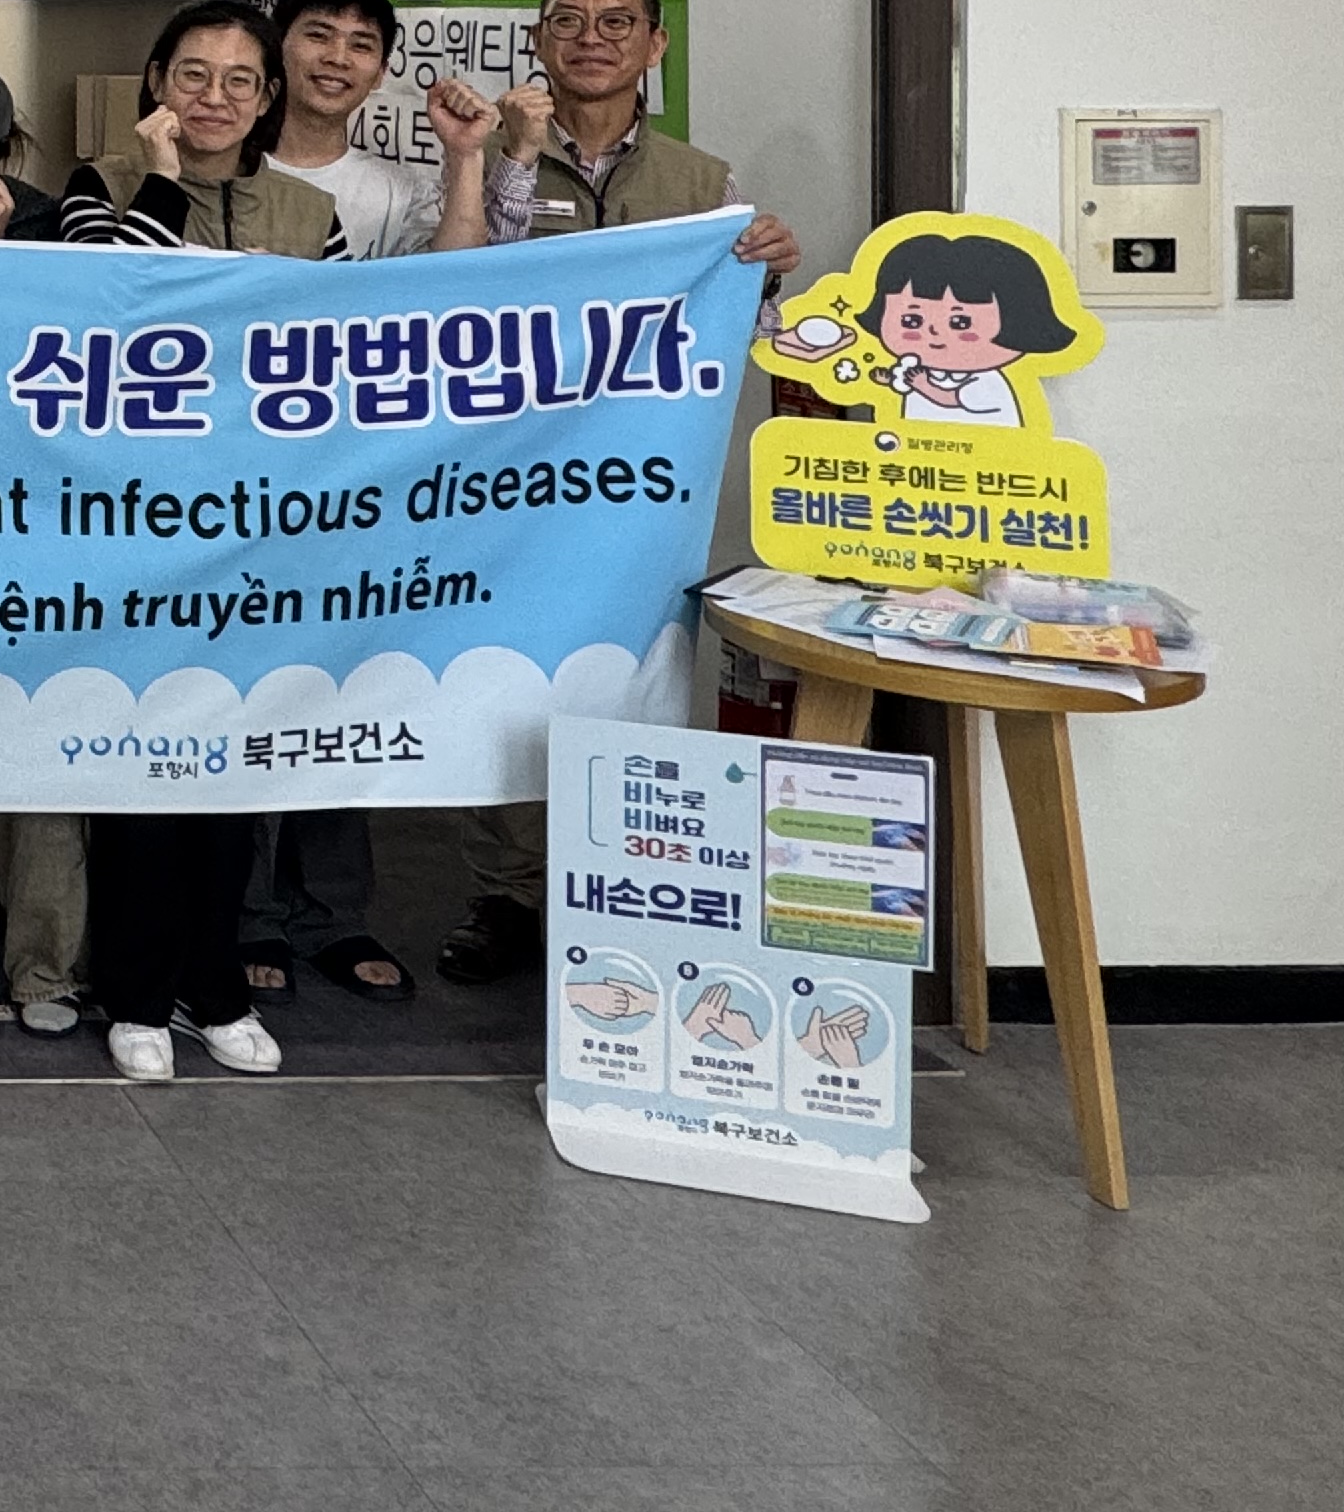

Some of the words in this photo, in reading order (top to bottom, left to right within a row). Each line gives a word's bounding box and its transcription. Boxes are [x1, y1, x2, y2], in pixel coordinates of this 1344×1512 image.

[14, 325, 212, 433] 쉬운
[247, 296, 720, 428] 방법입니다.
[60, 478, 382, 538] infectious
[406, 455, 692, 522] diseases.
[783, 454, 870, 485] 기침한
[878, 464, 967, 491] 후에는
[977, 470, 1068, 502] 반드시
[771, 487, 873, 530] 올바른
[884, 502, 989, 542] 손씻기
[1001, 509, 1089, 551] 실천!
[122, 569, 303, 640] truyền
[320, 554, 491, 624] nhiễm.
[242, 722, 425, 768] 북구보건소
[624, 753, 680, 781] 손을
[148, 761, 198, 779] 포항시
[624, 780, 706, 812] 비누로
[624, 807, 705, 838] 비벼요
[624, 834, 692, 864] 30초
[699, 845, 751, 870] 이상
[566, 871, 742, 932] 내손으로!
[713, 1120, 798, 1146] 북구보건소
